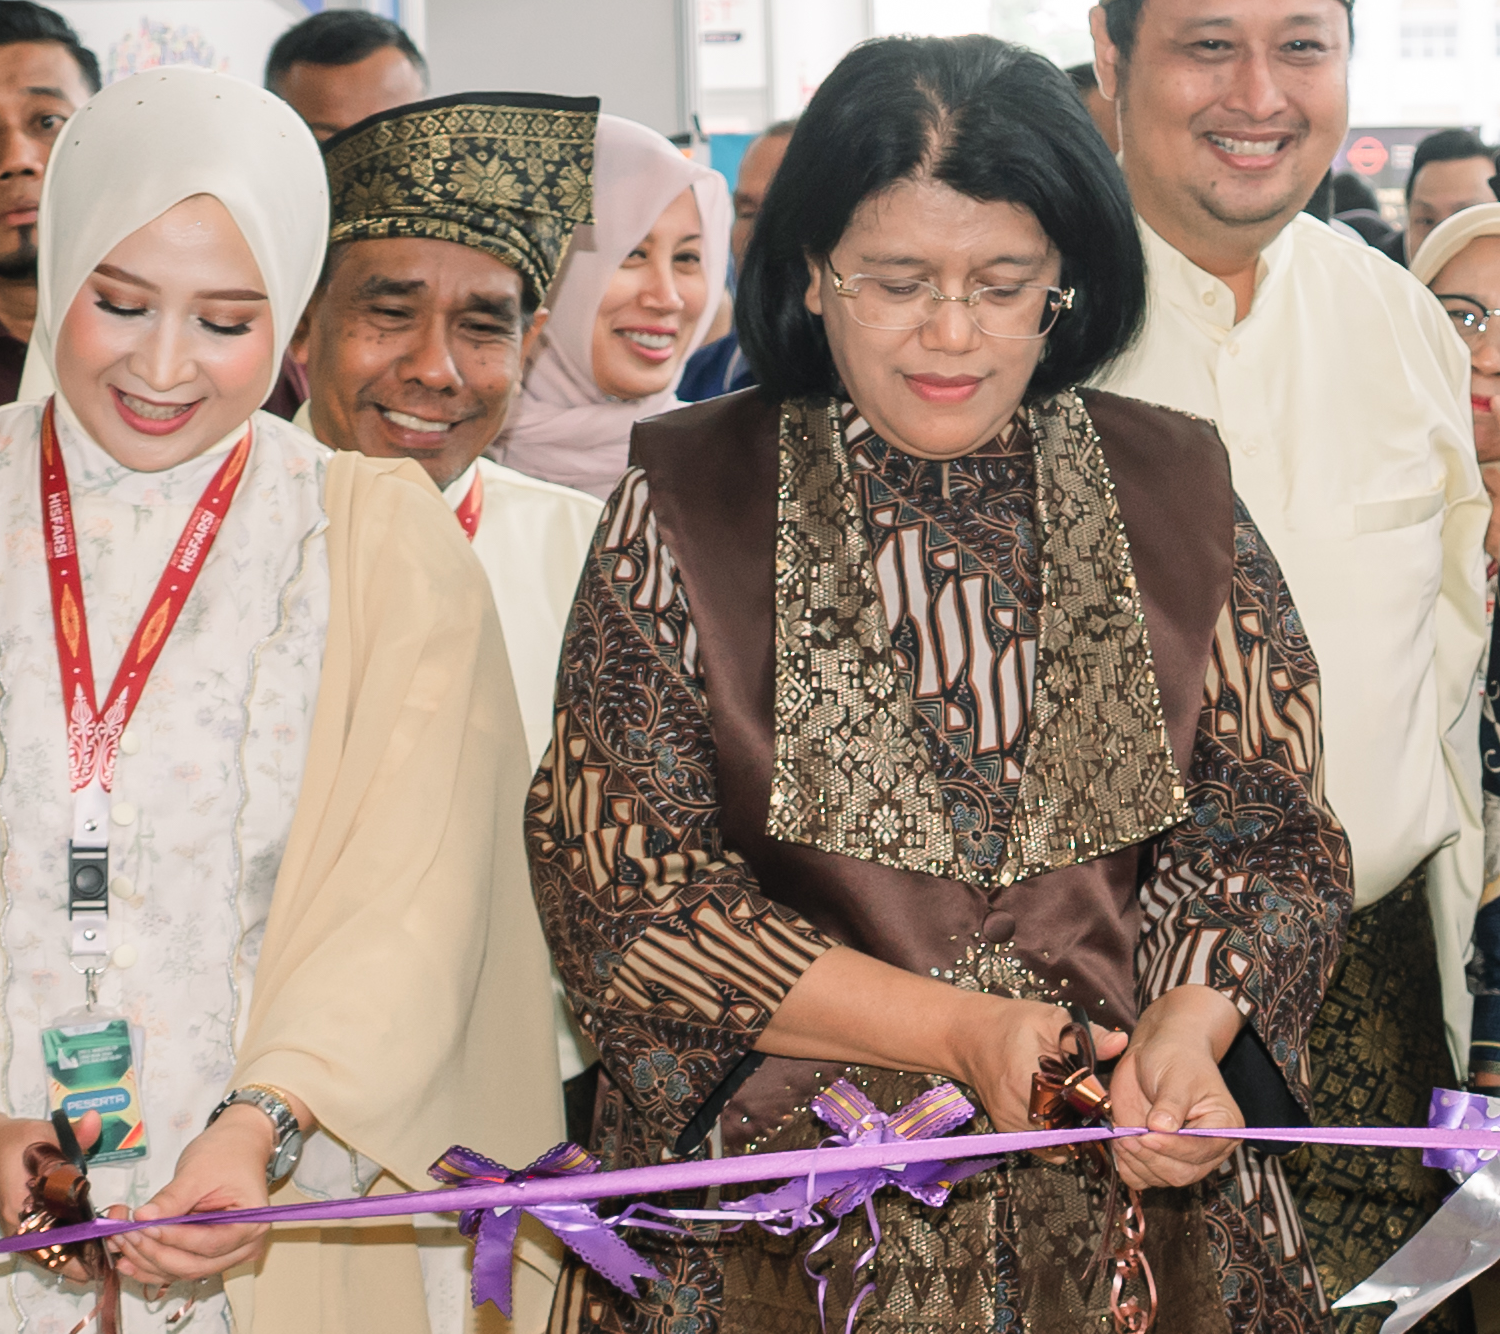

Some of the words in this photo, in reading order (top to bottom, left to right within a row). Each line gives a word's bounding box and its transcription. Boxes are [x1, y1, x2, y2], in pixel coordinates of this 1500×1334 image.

[48, 492, 68, 559] HISFARSI
[177, 509, 216, 573] HISFARSI
[66, 1093, 126, 1111] PESERTA
